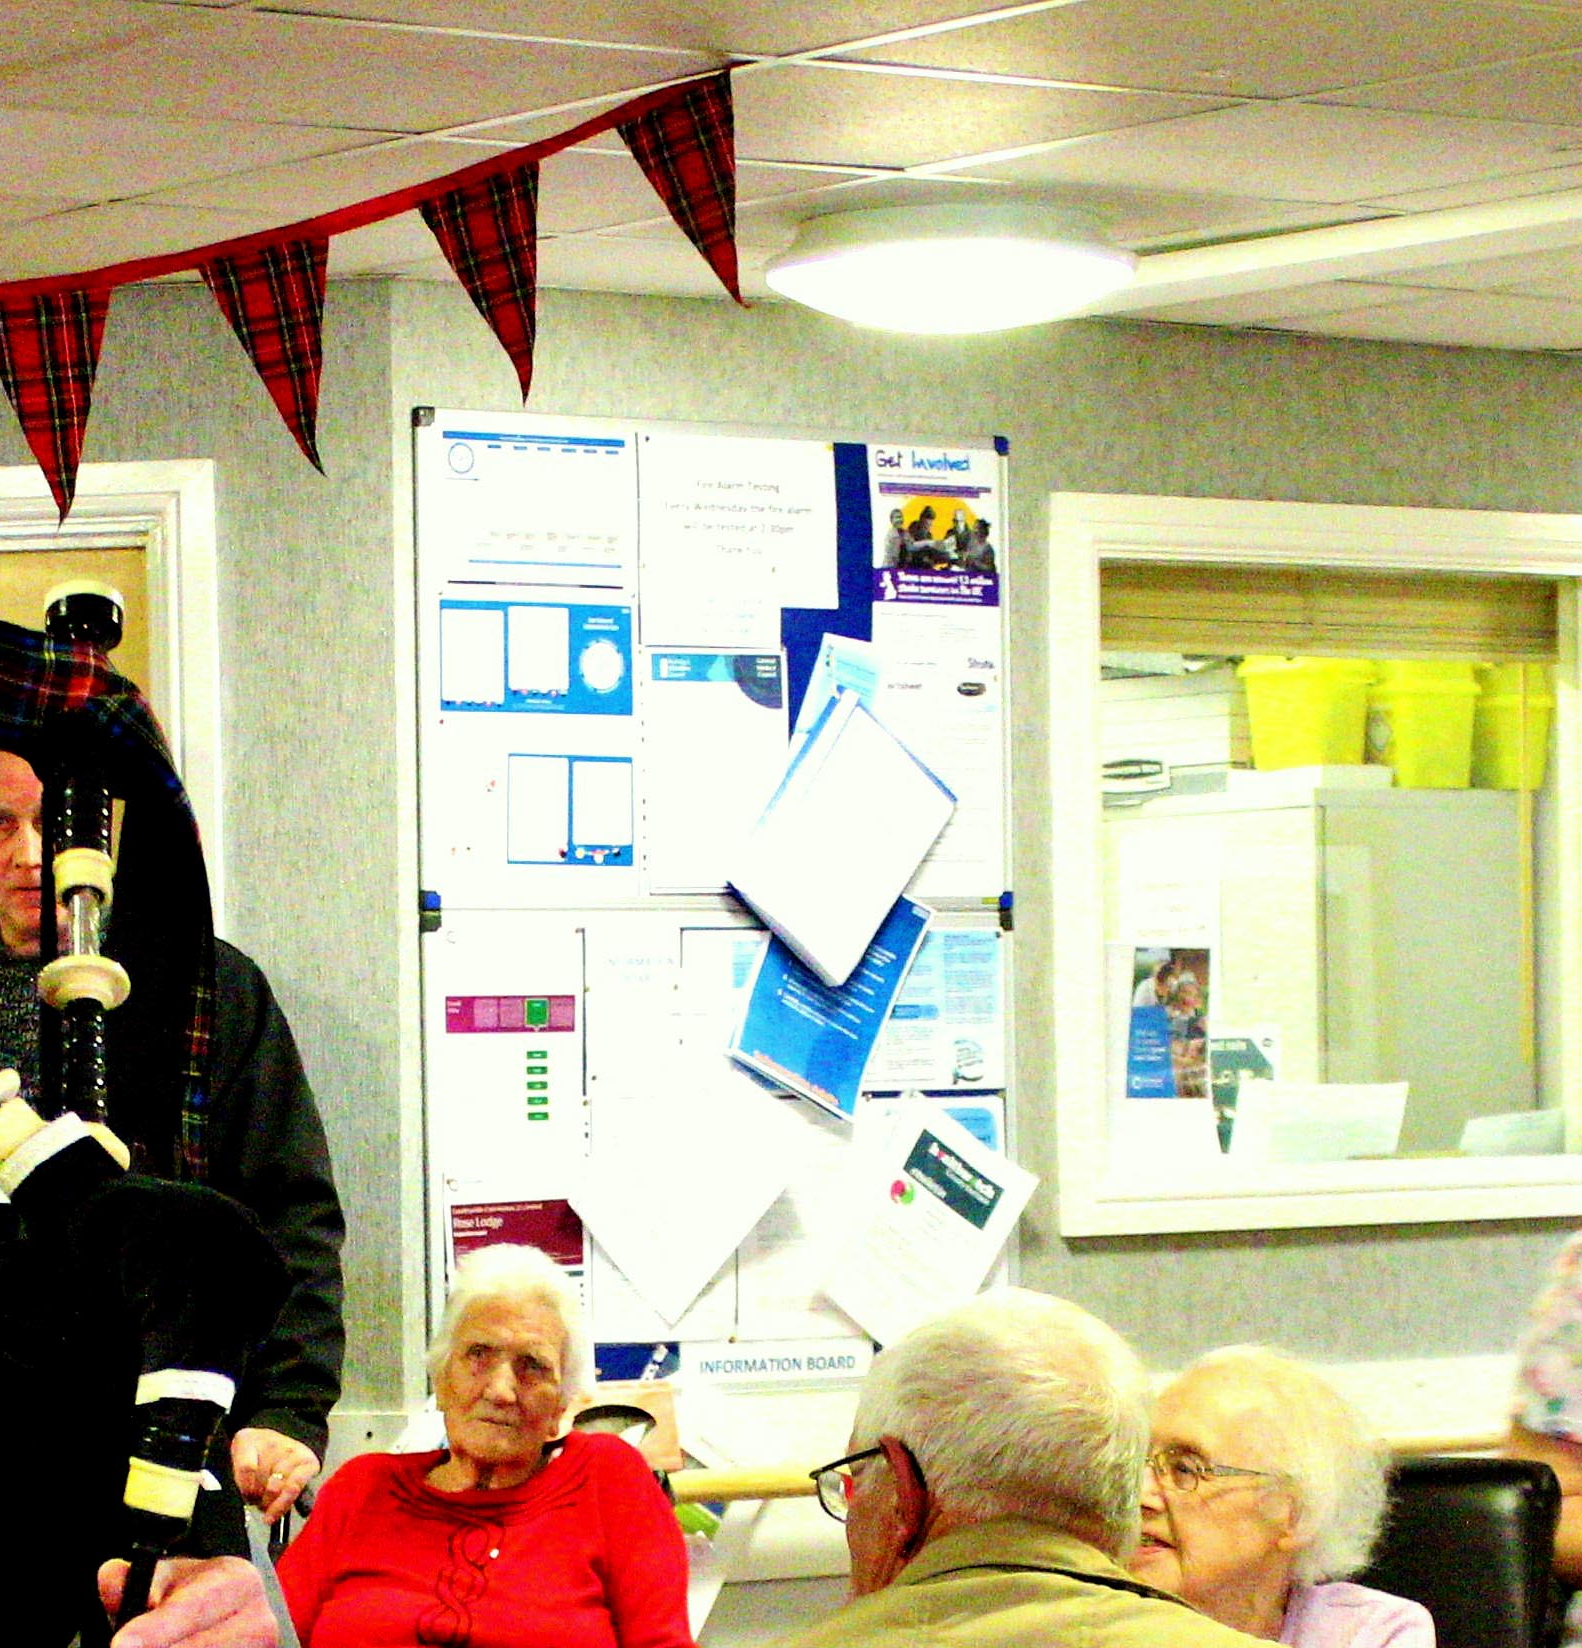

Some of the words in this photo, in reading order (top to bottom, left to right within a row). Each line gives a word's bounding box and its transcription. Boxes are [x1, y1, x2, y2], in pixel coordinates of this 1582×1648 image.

[875, 450, 903, 469] Get
[911, 450, 970, 472] Involved
[699, 1357, 802, 1374] INFORMATION
[806, 1354, 856, 1371] BOARD
